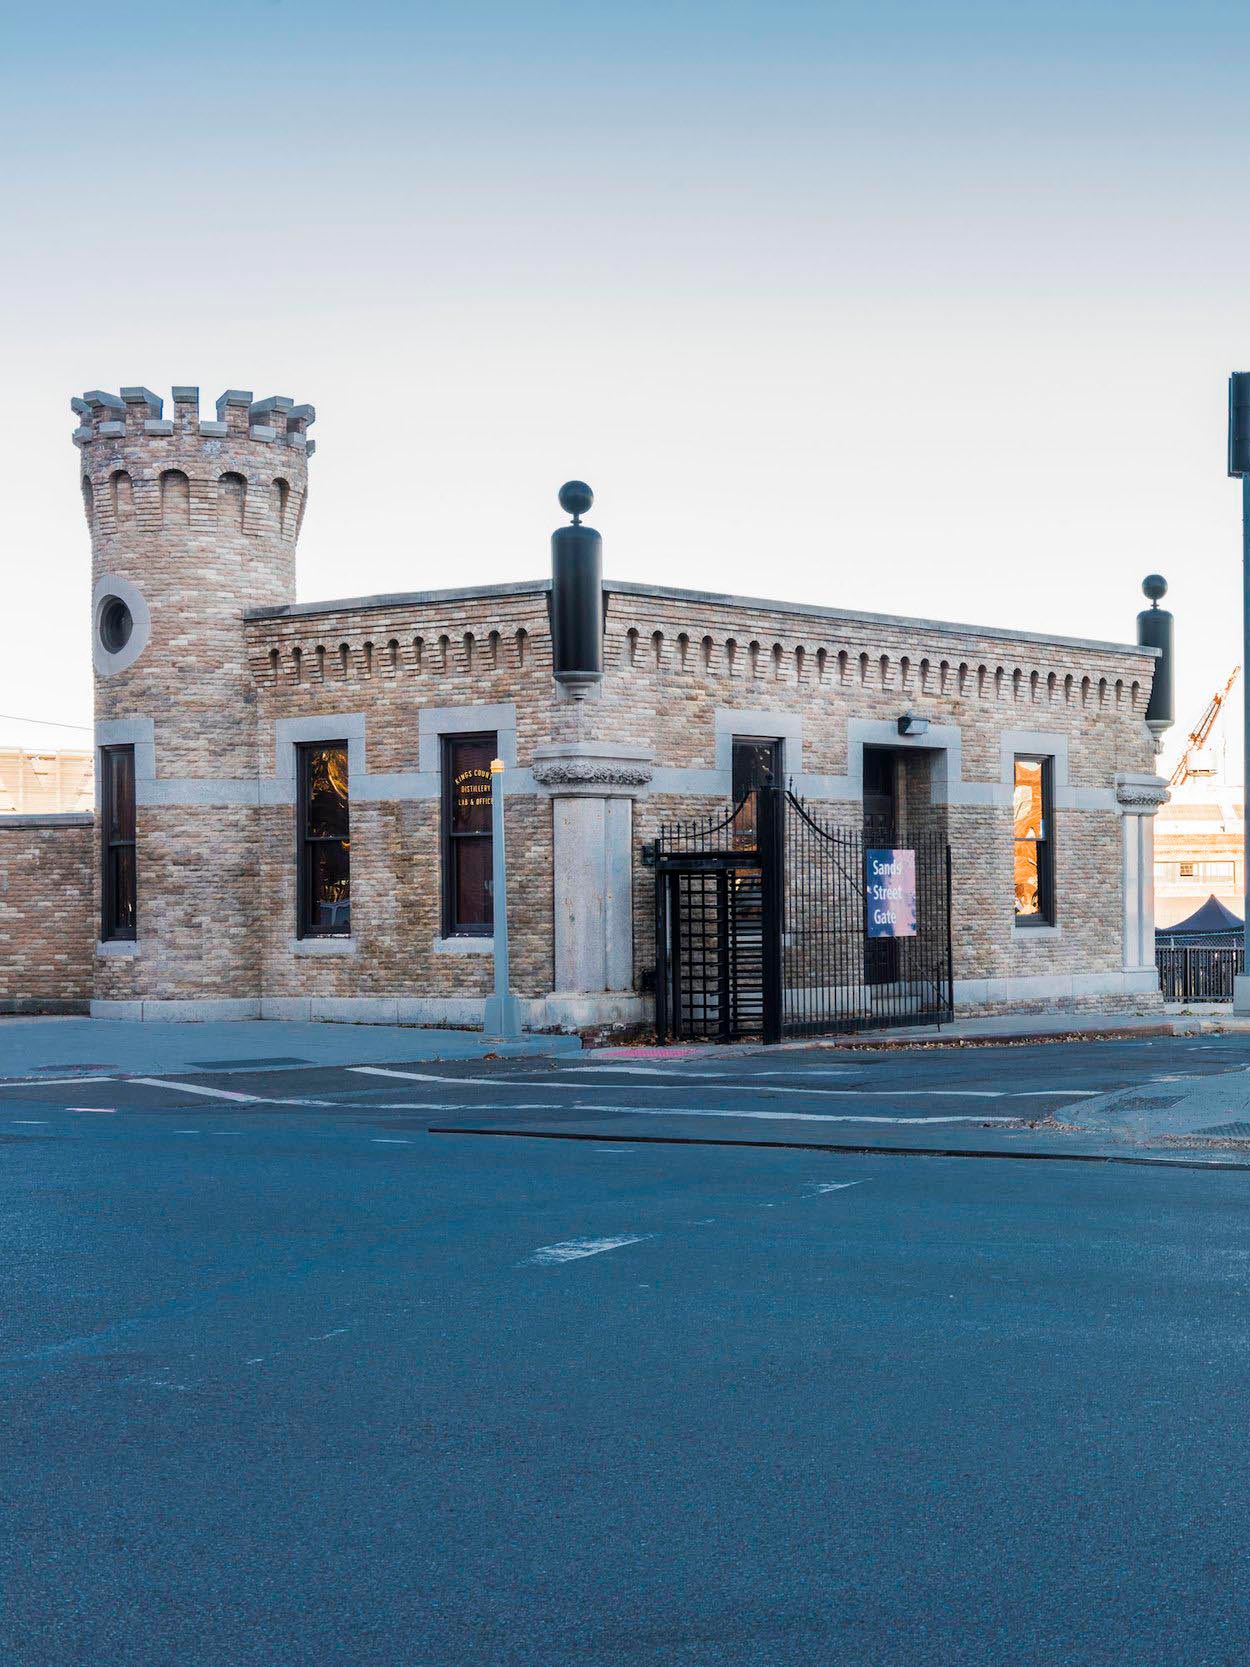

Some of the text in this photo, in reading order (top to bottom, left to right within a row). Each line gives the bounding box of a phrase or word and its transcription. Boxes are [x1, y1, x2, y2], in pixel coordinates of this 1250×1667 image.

[455, 769, 493, 784] KINGS COUNT
[461, 784, 491, 793] DISTILLERY
[458, 798, 469, 806] LAB
[470, 798, 475, 806] &
[873, 859, 902, 875] Sands
[873, 884, 903, 900] Street
[874, 909, 897, 924] Gate
